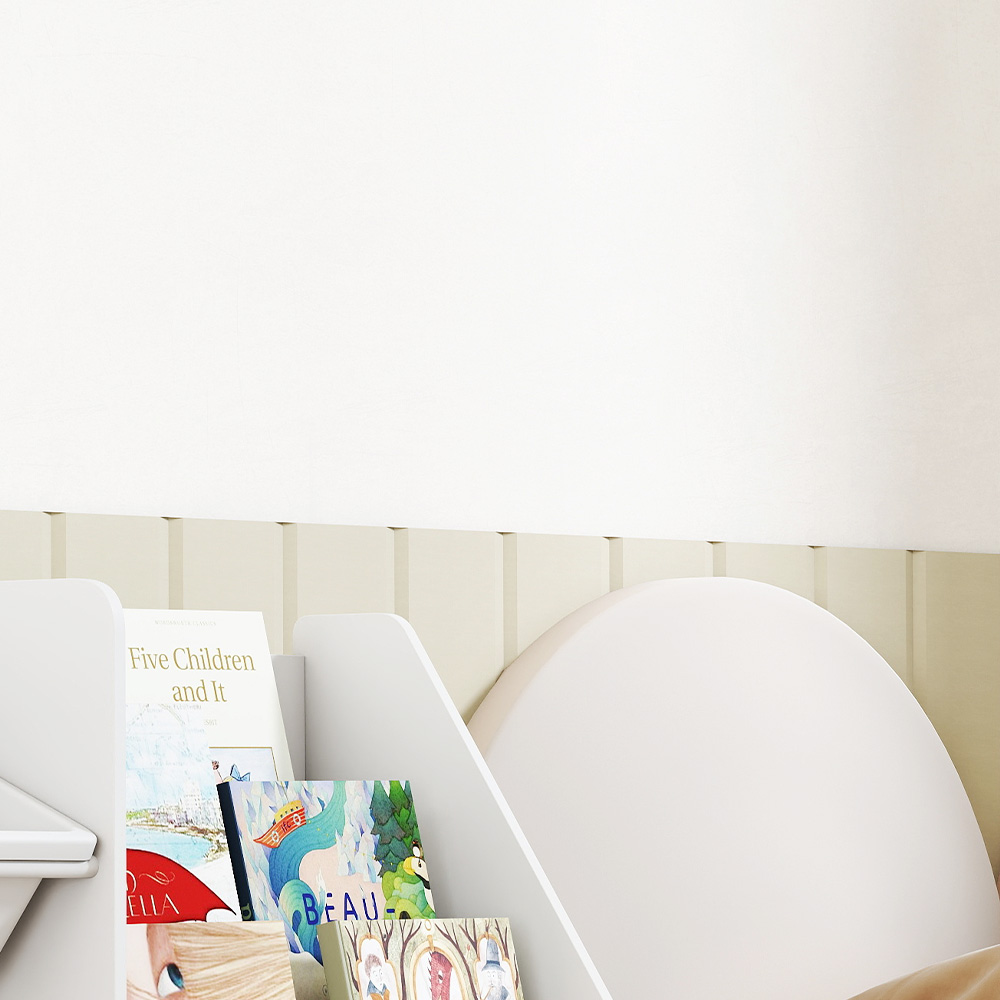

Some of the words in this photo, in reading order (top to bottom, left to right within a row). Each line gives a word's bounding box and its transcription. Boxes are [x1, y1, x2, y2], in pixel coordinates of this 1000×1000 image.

[128, 647, 170, 670] Five
[172, 647, 256, 671] Children
[171, 679, 210, 703] and
[211, 680, 228, 703] It
[126, 893, 180, 918] ELLA
